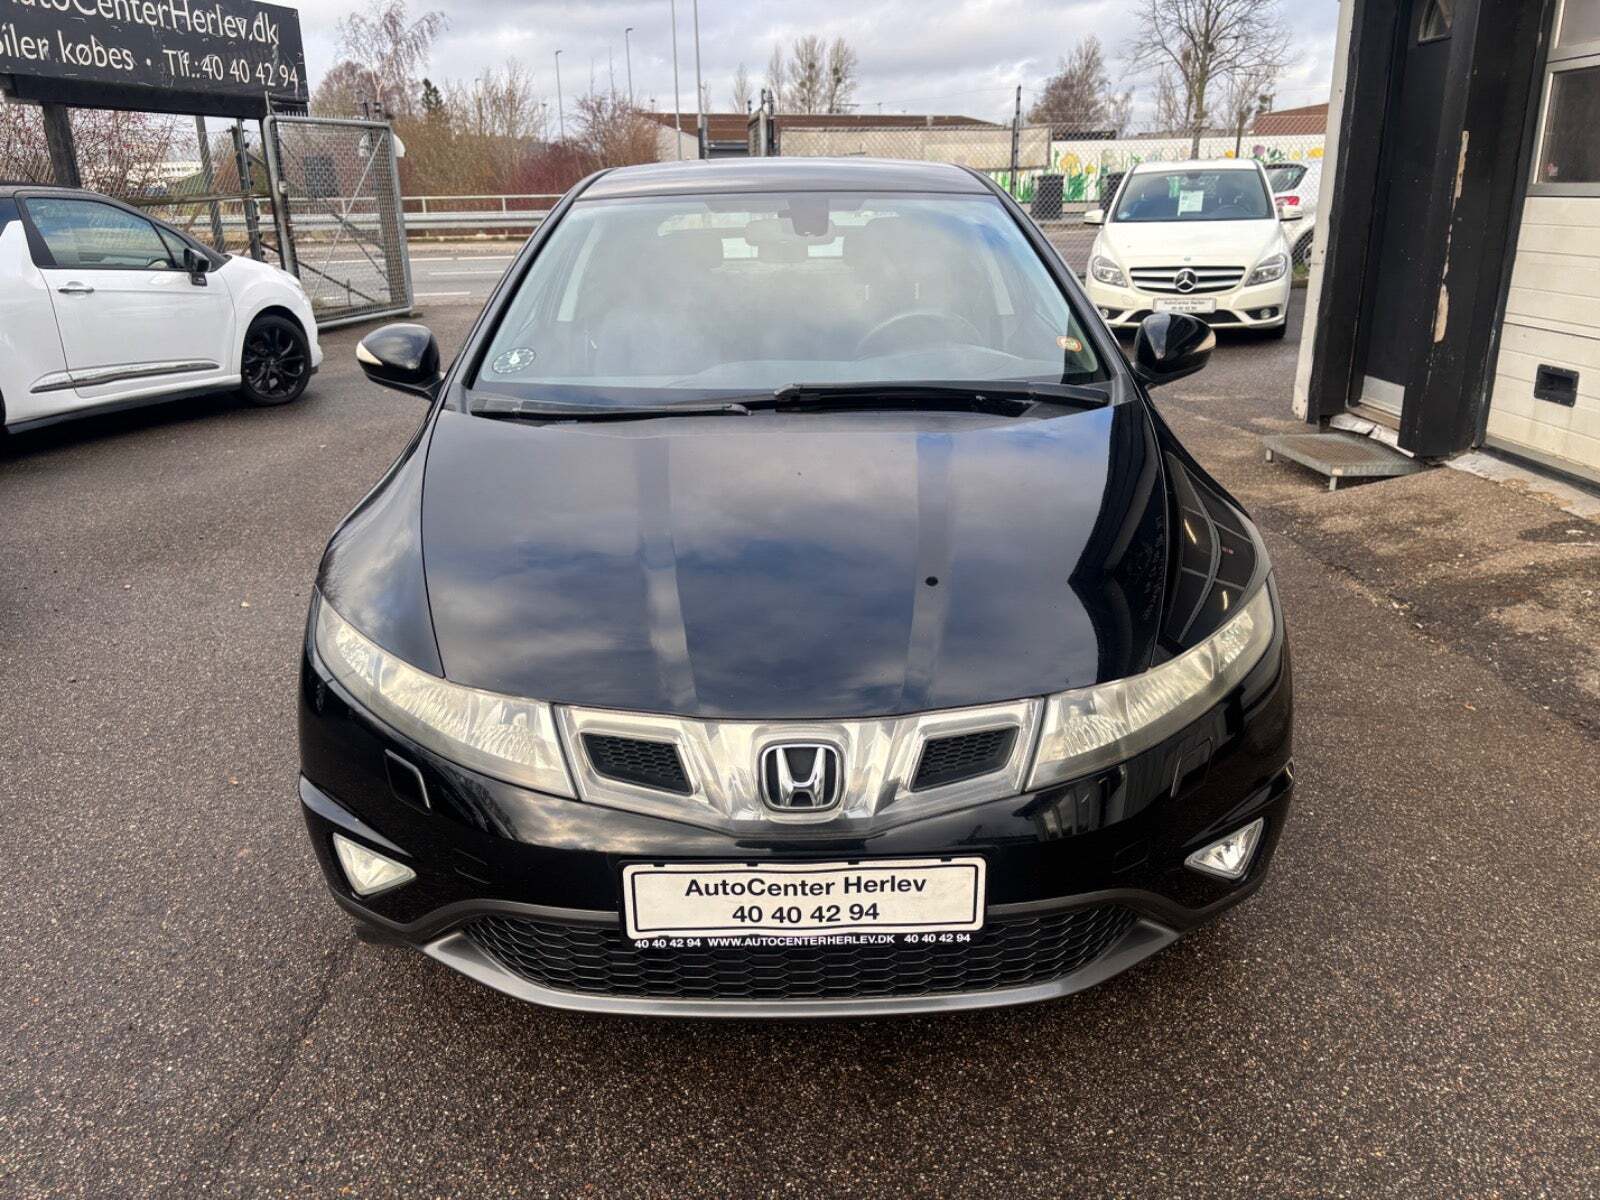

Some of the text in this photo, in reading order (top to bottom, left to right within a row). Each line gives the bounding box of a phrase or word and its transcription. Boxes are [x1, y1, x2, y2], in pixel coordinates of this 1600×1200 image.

[11, 0, 279, 45] enterHerlev.dk
[57, 29, 135, 71] købes
[229, 58, 250, 84] 40
[256, 61, 276, 87] 42
[279, 64, 299, 90] 94
[684, 875, 927, 897] AutoCenter Herlev
[732, 902, 880, 924] 40 40 42 94
[634, 933, 971, 949] 40 40 42 94 WWW.AUTOCENTERHERLEV.DK 40 40 42 94
